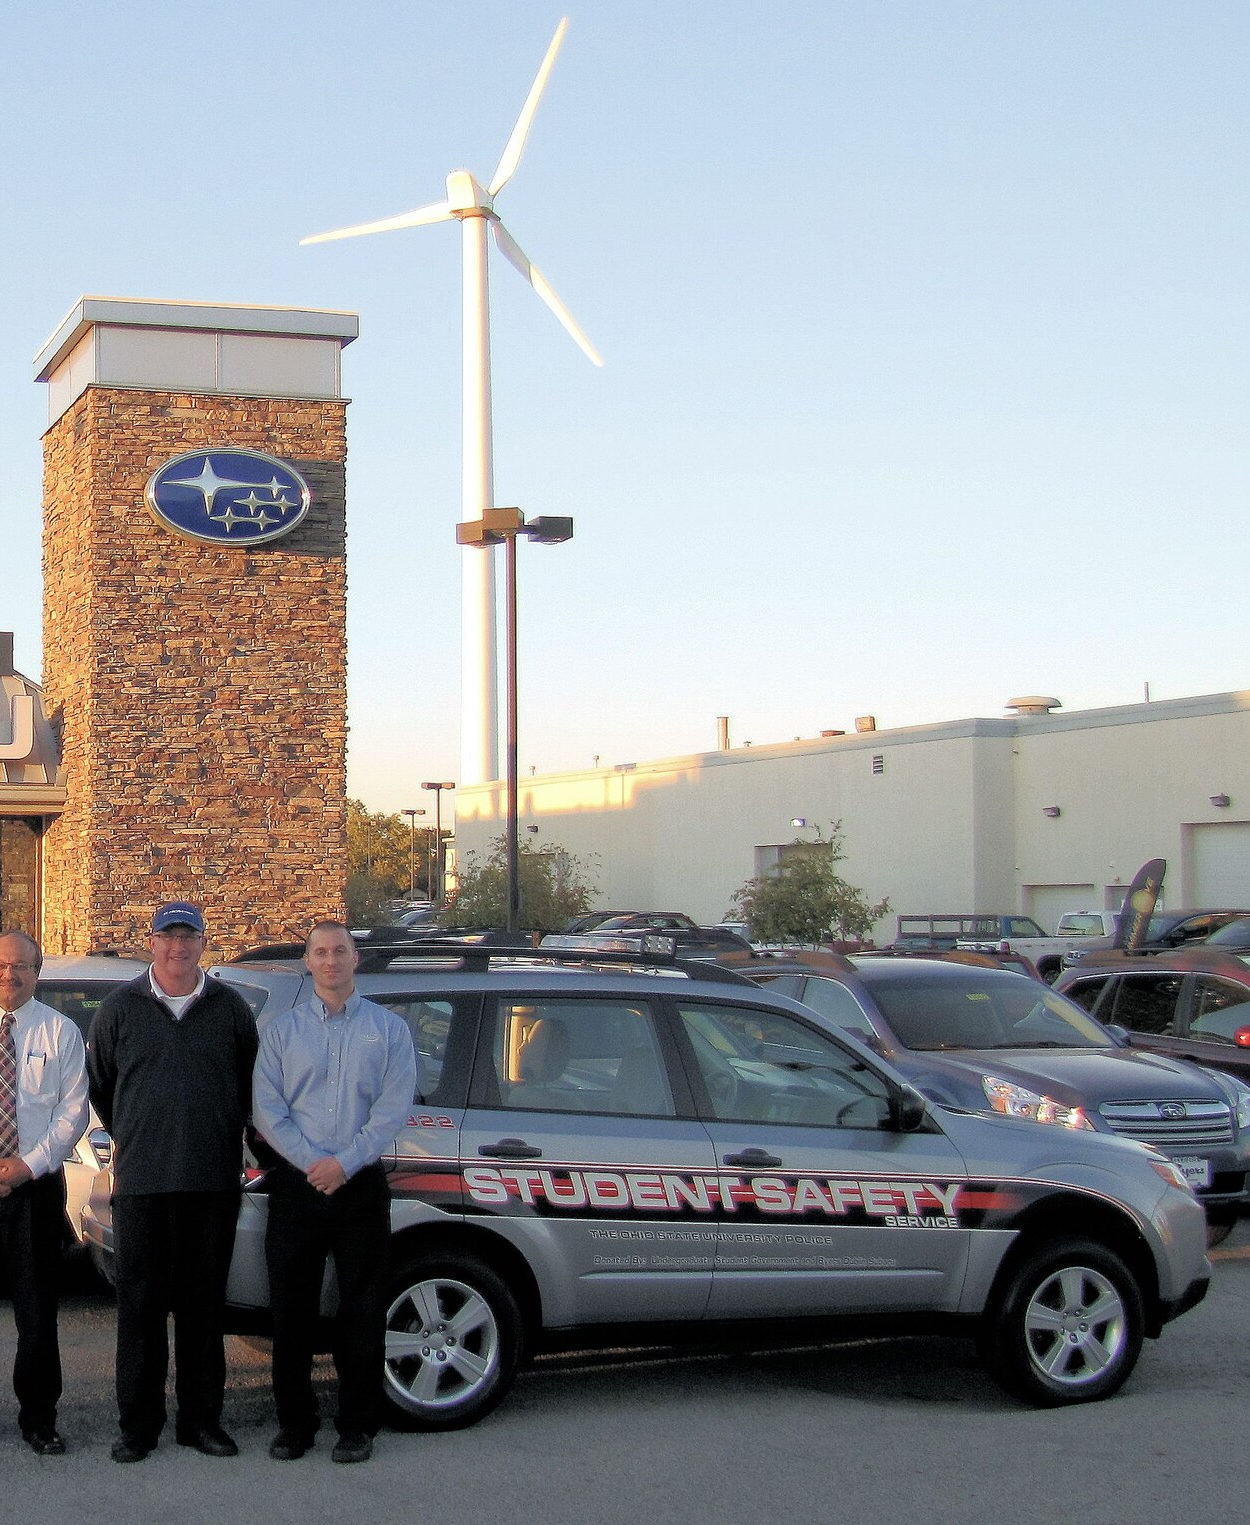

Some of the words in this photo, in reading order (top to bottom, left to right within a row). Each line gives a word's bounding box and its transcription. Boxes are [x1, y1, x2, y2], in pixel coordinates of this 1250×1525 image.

[463, 1167, 740, 1212] STUDENT
[751, 1176, 961, 1216] SAFETY
[884, 1215, 959, 1229] SERVICE
[589, 1228, 617, 1239] THE
[619, 1230, 654, 1240] OHIO
[657, 1231, 701, 1242] STATE
[701, 1232, 782, 1244] UNIVERSITY
[784, 1234, 834, 1246] POLICE
